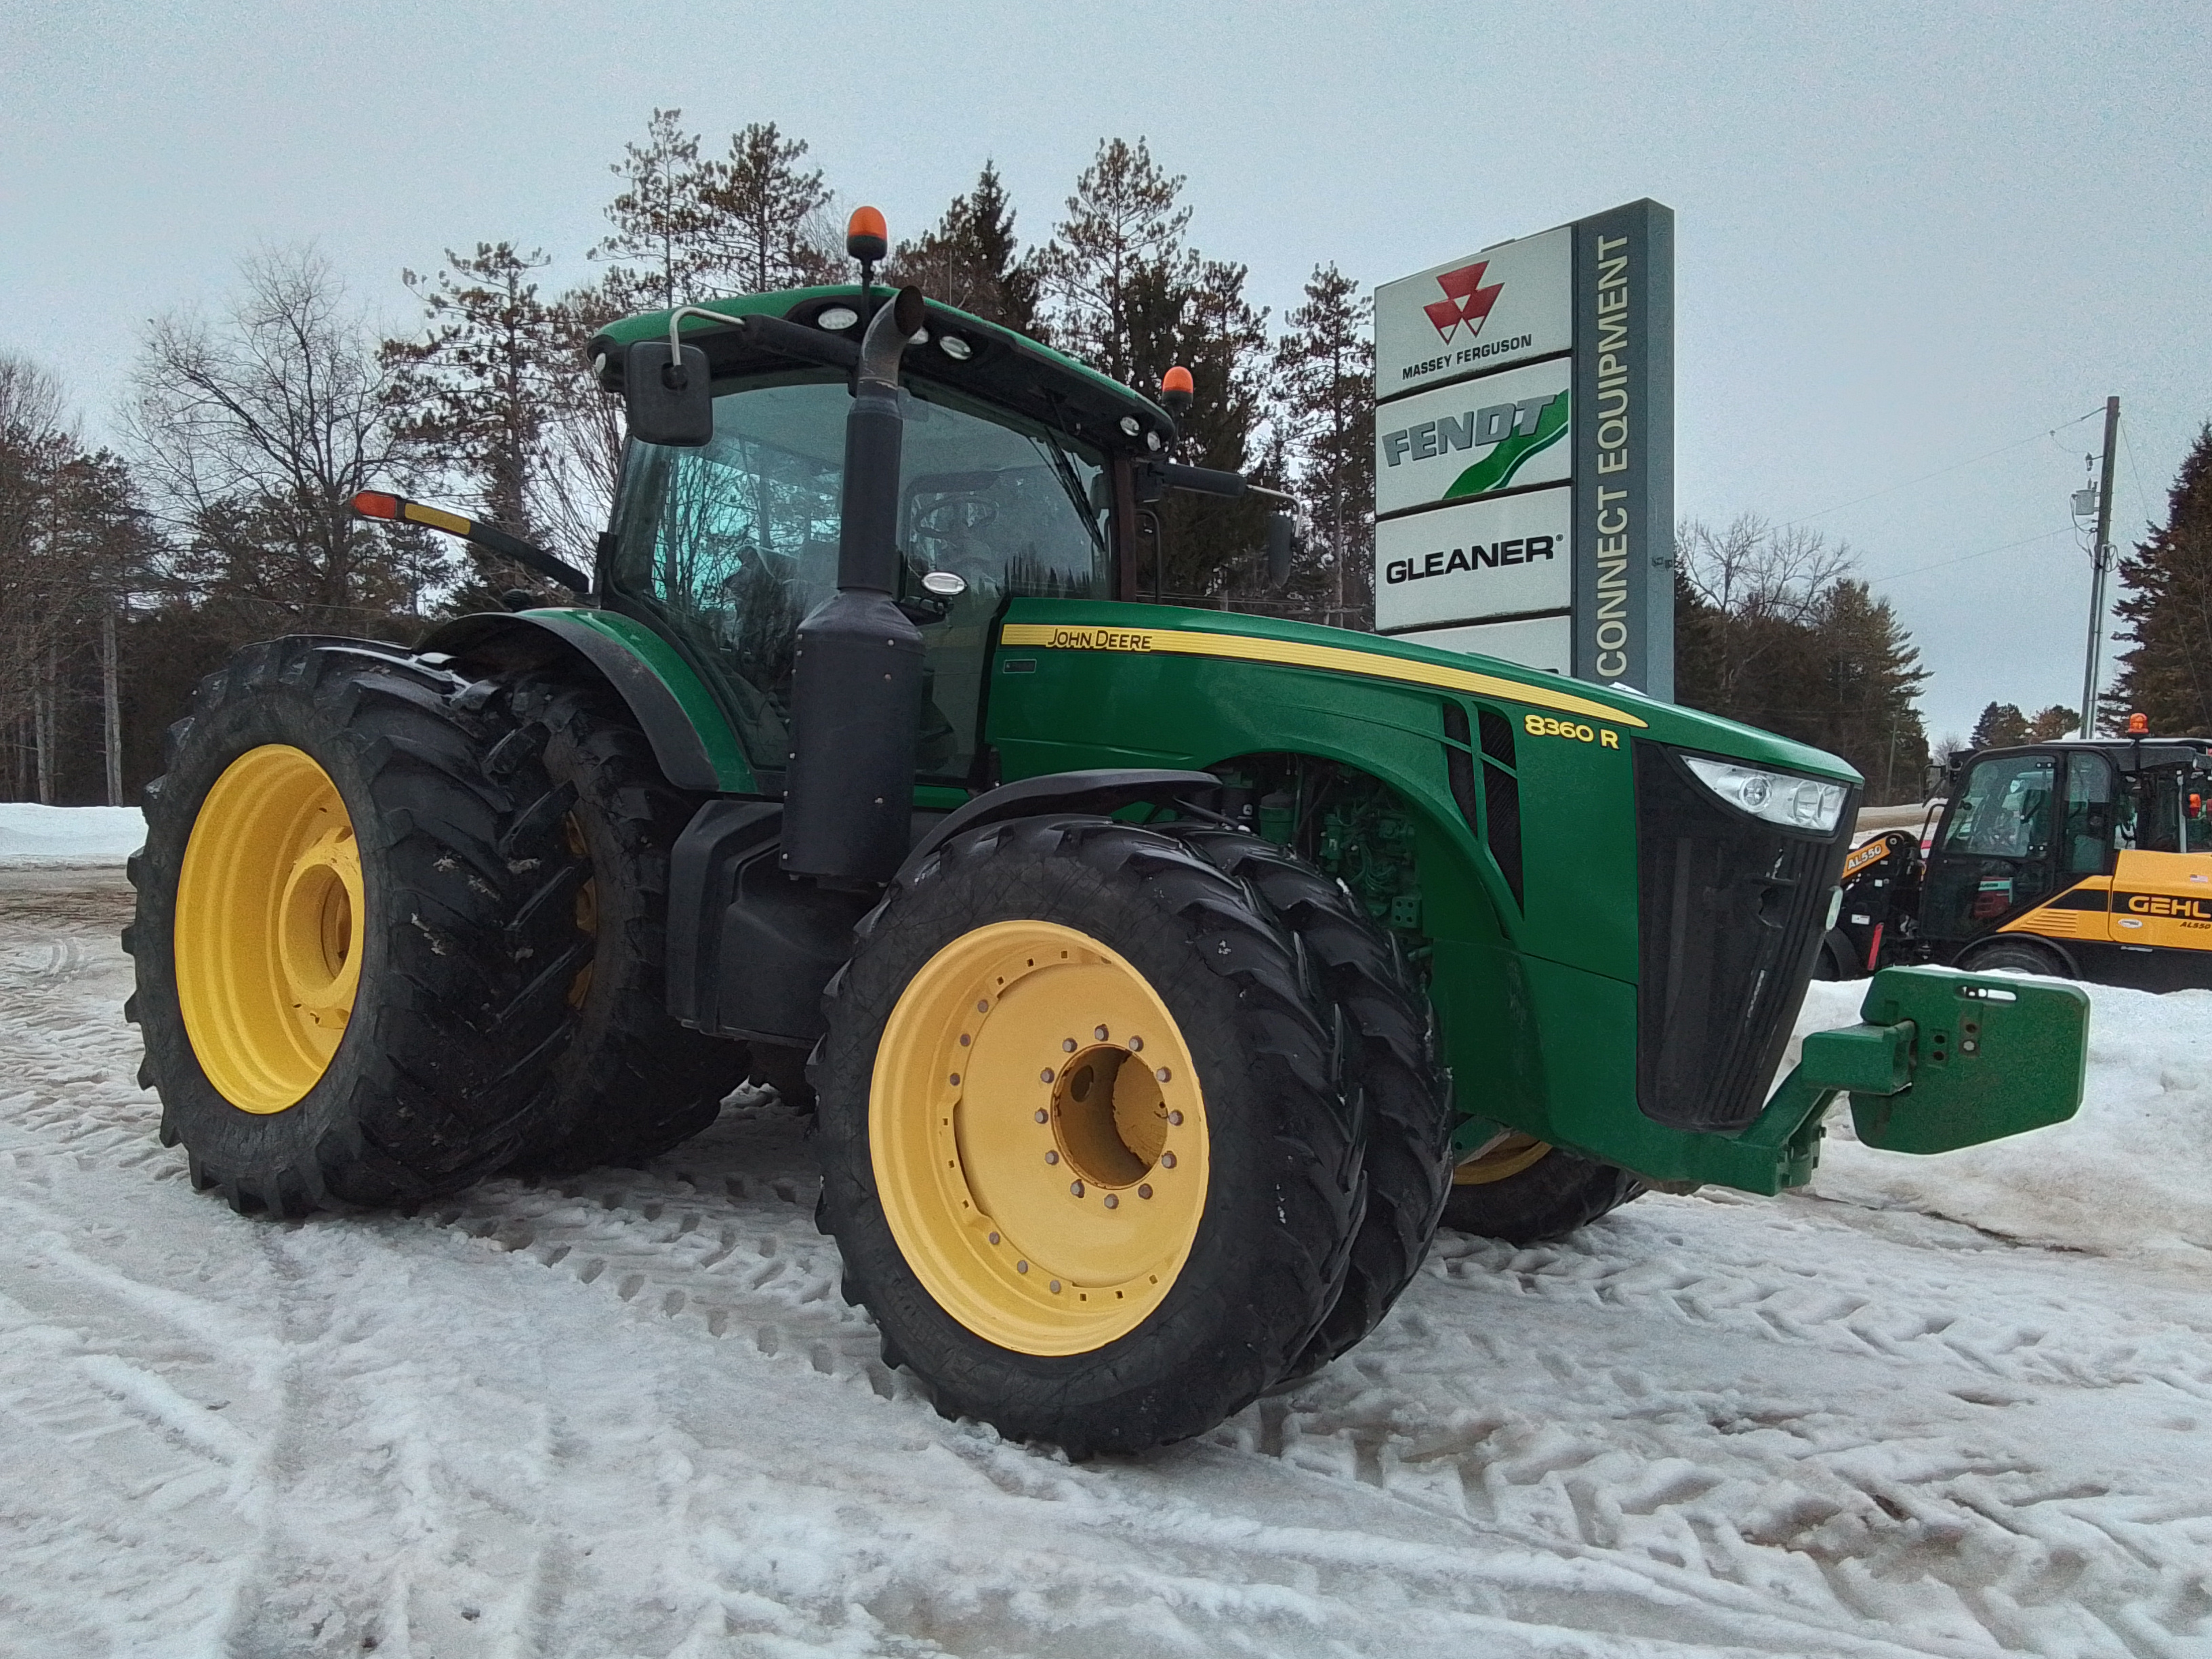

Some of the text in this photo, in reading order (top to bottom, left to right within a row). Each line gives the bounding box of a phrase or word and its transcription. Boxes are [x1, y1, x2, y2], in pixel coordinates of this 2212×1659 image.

[1401, 333, 1532, 380] MASSEY FERGUSON
[1381, 394, 1557, 468] FENDT
[1596, 234, 1628, 677] CONNECT EQUIPMENT
[1047, 628, 1153, 650] JOHN DEERE
[1525, 714, 1620, 750] 8360 R
[1847, 844, 1882, 870] AL550
[2128, 895, 2212, 918] GEHL
[2179, 921, 2211, 930] AL550
